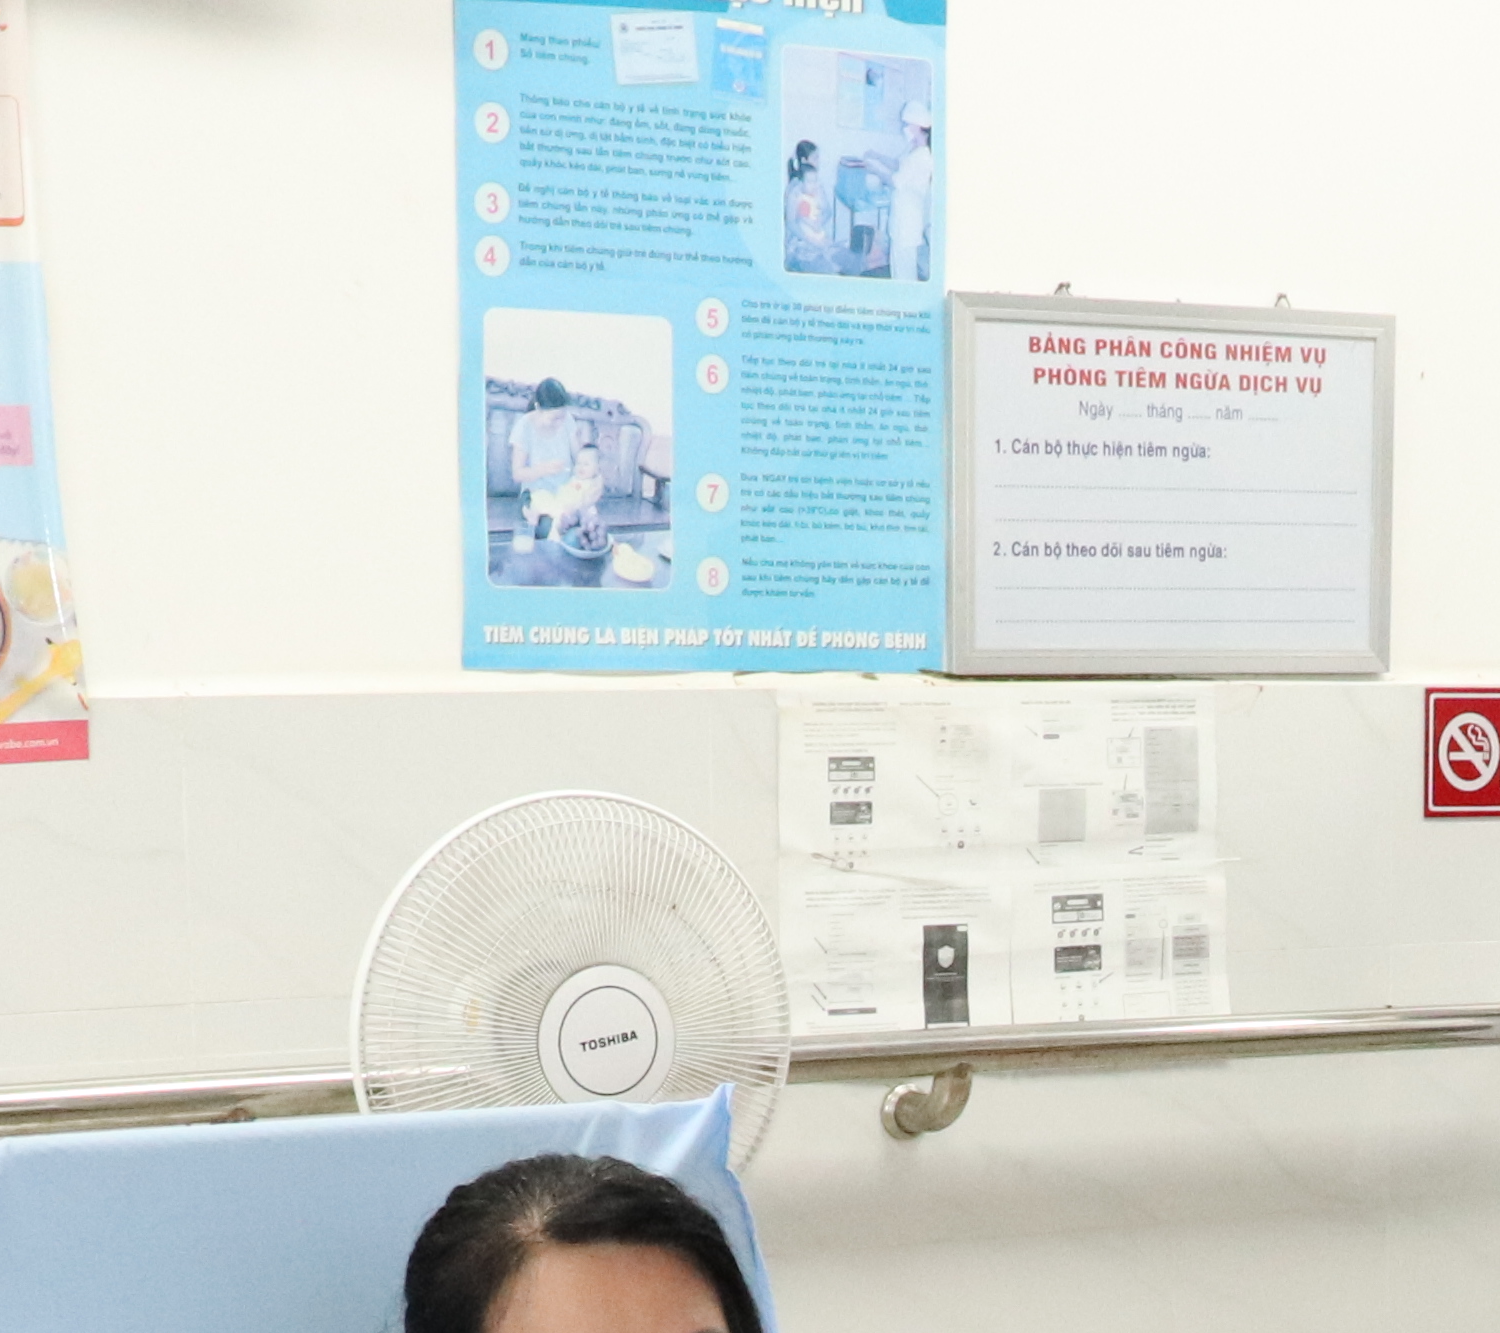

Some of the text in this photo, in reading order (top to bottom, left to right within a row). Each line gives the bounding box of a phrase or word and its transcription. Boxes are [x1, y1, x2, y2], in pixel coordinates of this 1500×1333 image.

[485, 39, 495, 60] 1
[485, 112, 500, 133] 2
[486, 193, 500, 214] 3
[483, 246, 497, 267] 4
[706, 308, 719, 329] 5
[1029, 331, 1327, 369] BẢNG PHÂN CÔNG NHIỆM VỤ
[706, 364, 719, 385] 6
[1033, 363, 1323, 398] PHÒNG TIÊM NGỪA DỊCH VỤ
[1079, 401, 1244, 423] Ngày tháng năm
[995, 438, 1211, 462] 1. Cán bộ thực hiện tiêm ngừa:
[706, 484, 719, 504] 7
[993, 540, 1227, 563] 2. Cán bộ theo dõi sau tiêm ngừa:
[708, 567, 719, 587] 8
[484, 623, 525, 645] TIÊM
[621, 627, 660, 650] BIỆN
[713, 625, 744, 647] TỐT
[884, 629, 928, 654] BỆNH
[579, 1030, 639, 1052] TOSHIBA
